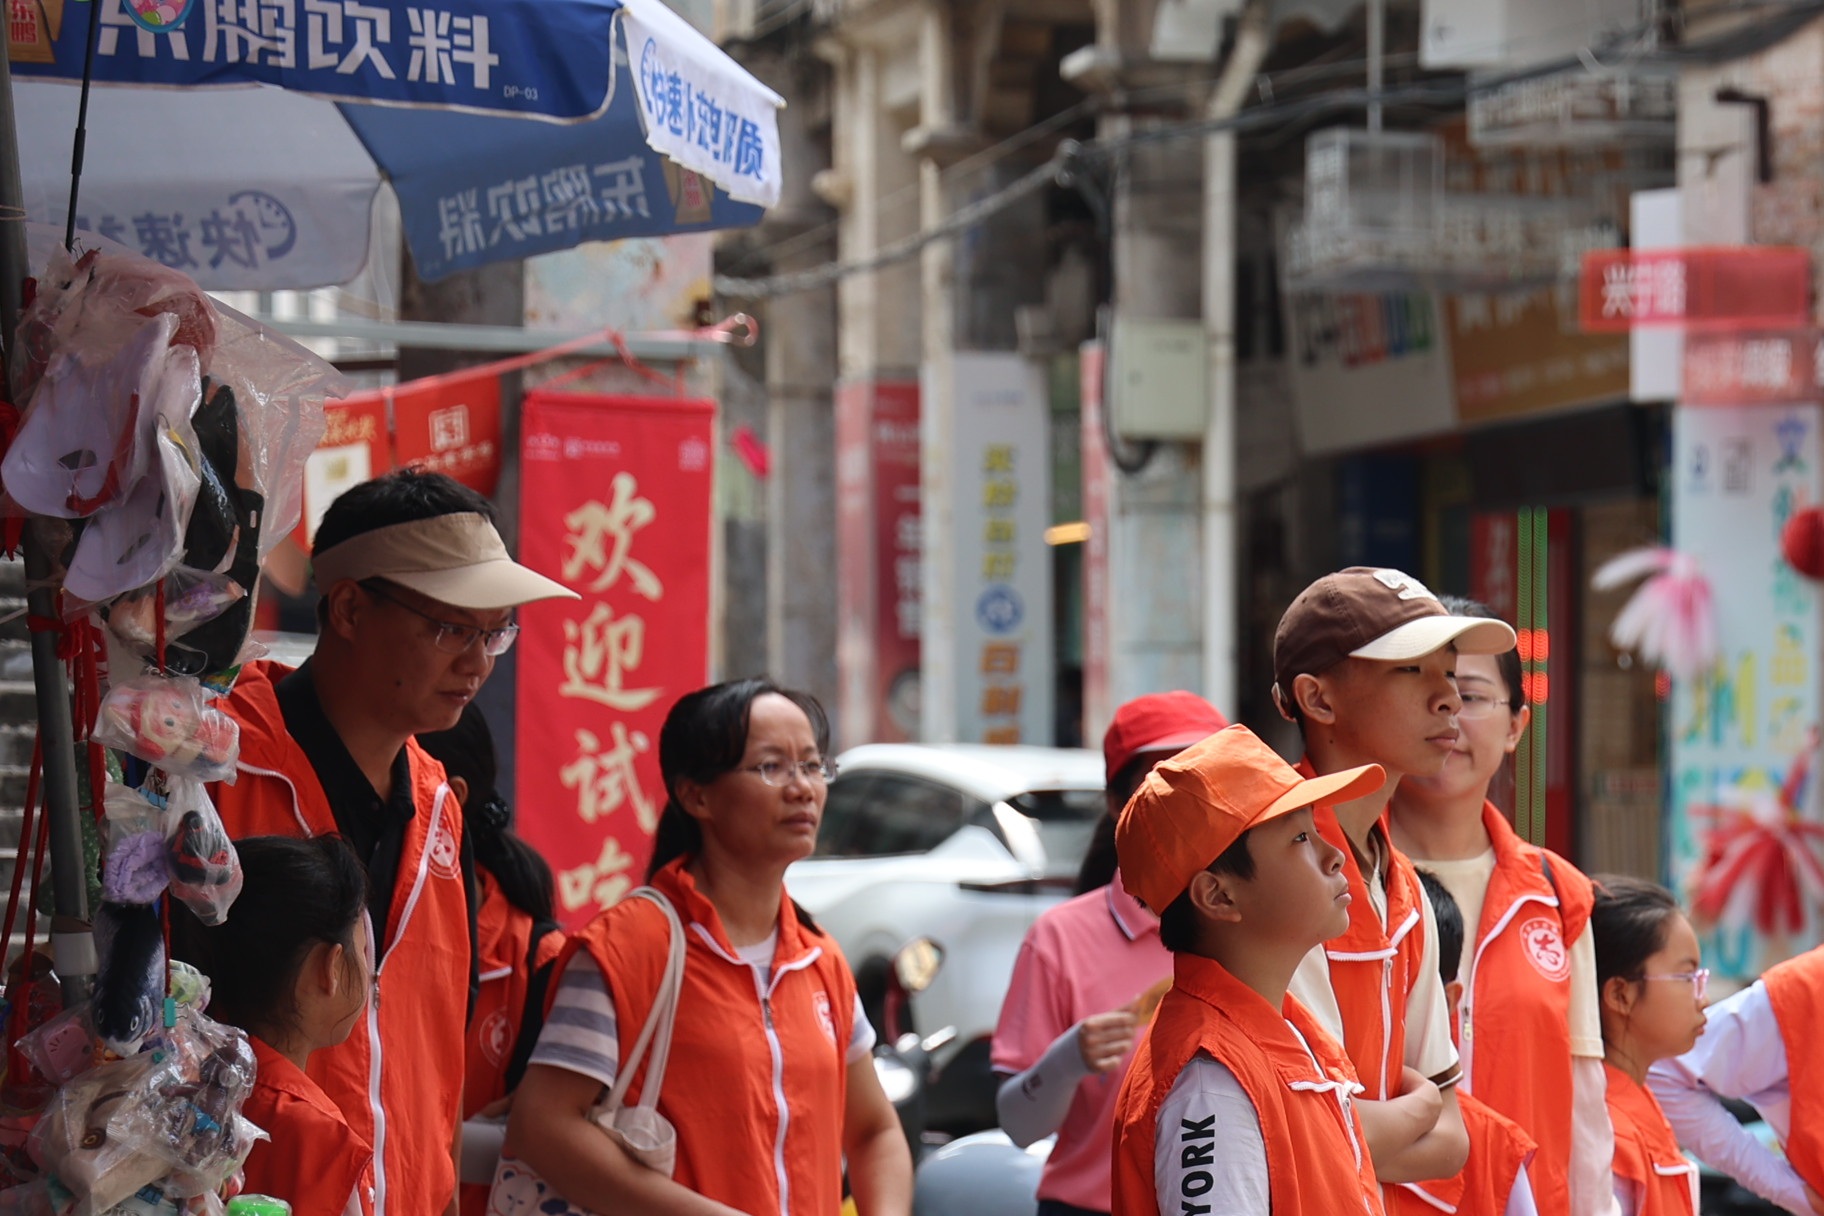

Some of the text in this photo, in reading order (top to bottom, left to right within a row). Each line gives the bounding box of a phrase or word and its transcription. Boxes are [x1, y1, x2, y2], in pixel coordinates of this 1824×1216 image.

[503, 83, 539, 101] DP-03
[558, 471, 664, 912] 欢迎试吃
